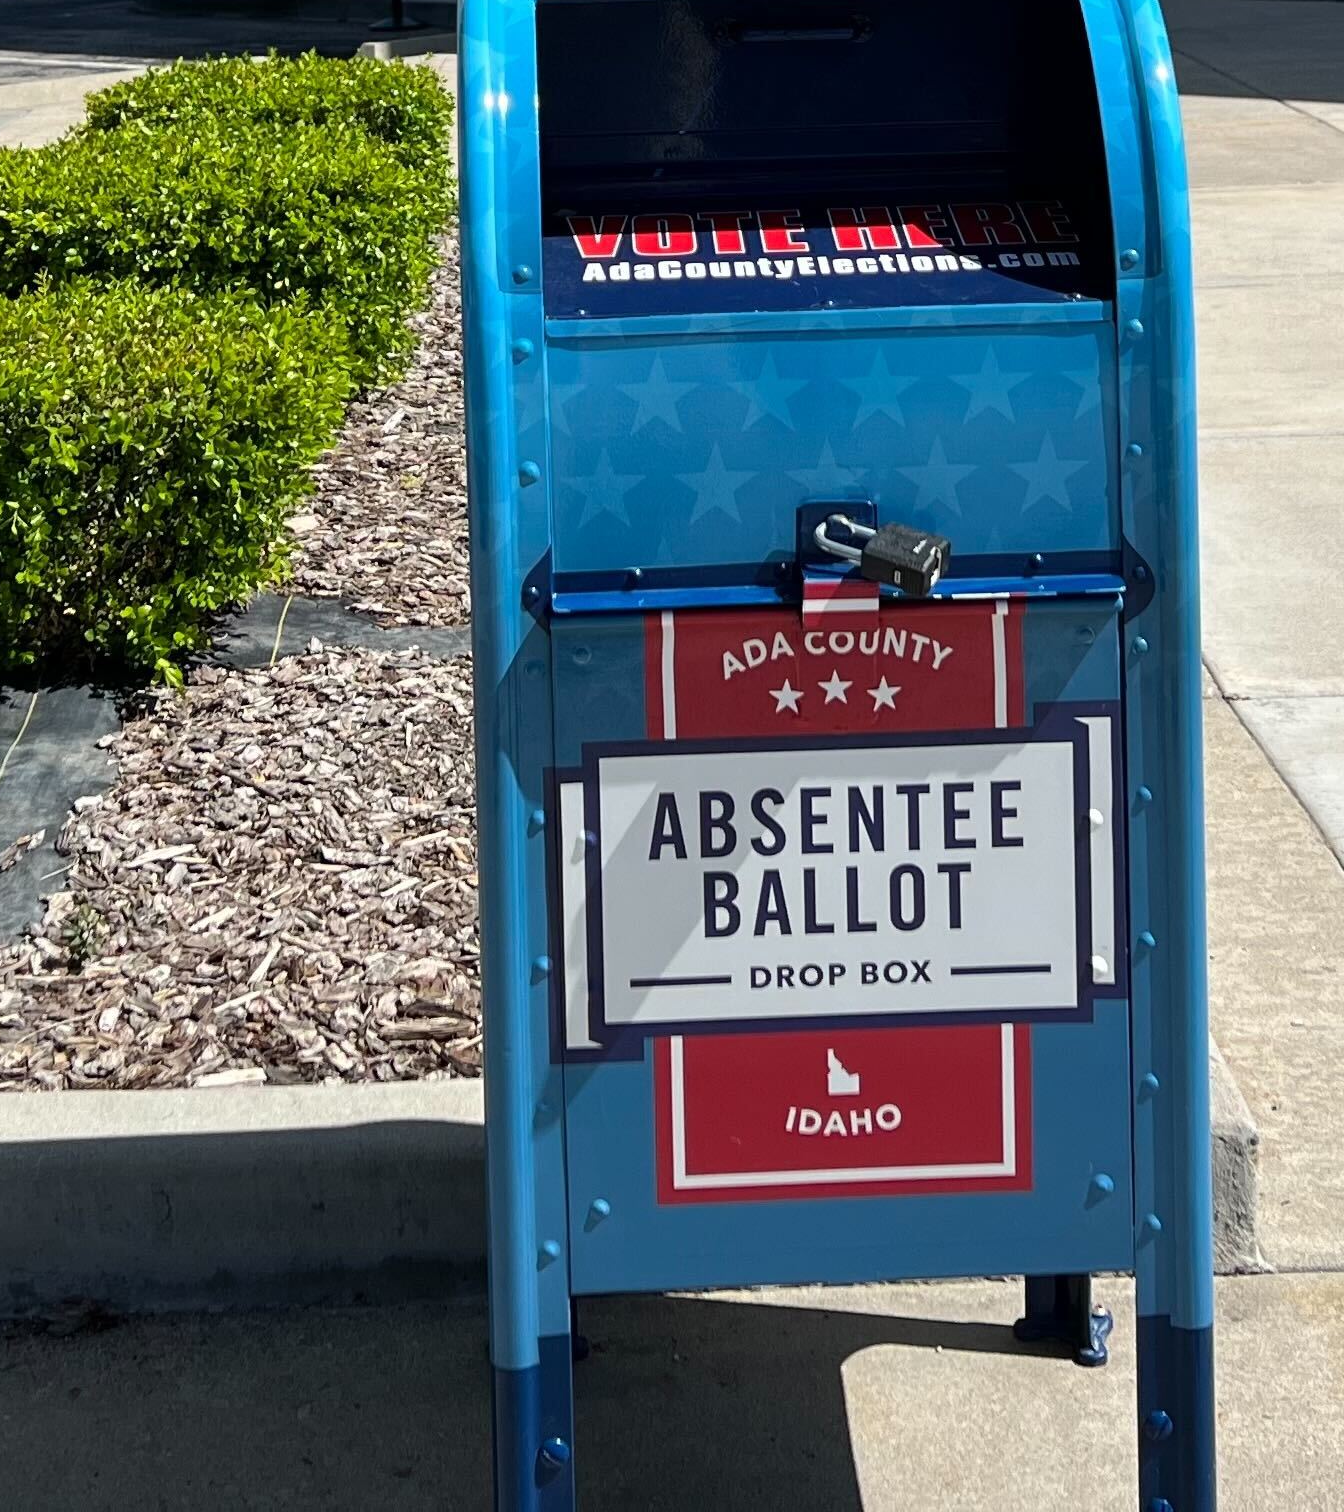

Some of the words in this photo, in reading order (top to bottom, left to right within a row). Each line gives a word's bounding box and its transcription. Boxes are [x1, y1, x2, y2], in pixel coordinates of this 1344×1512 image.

[564, 209, 810, 259] VOTE
[827, 201, 1081, 253] HERE
[582, 249, 1082, 283] AdaCountyElections.com
[722, 631, 796, 681] ADA
[804, 626, 954, 672] COUNTY
[648, 780, 1026, 862] ABSENTEE
[703, 862, 974, 939] BALLOT
[749, 963, 847, 990] DROP
[860, 959, 934, 986] BOX
[784, 1102, 904, 1139] IDAHO
